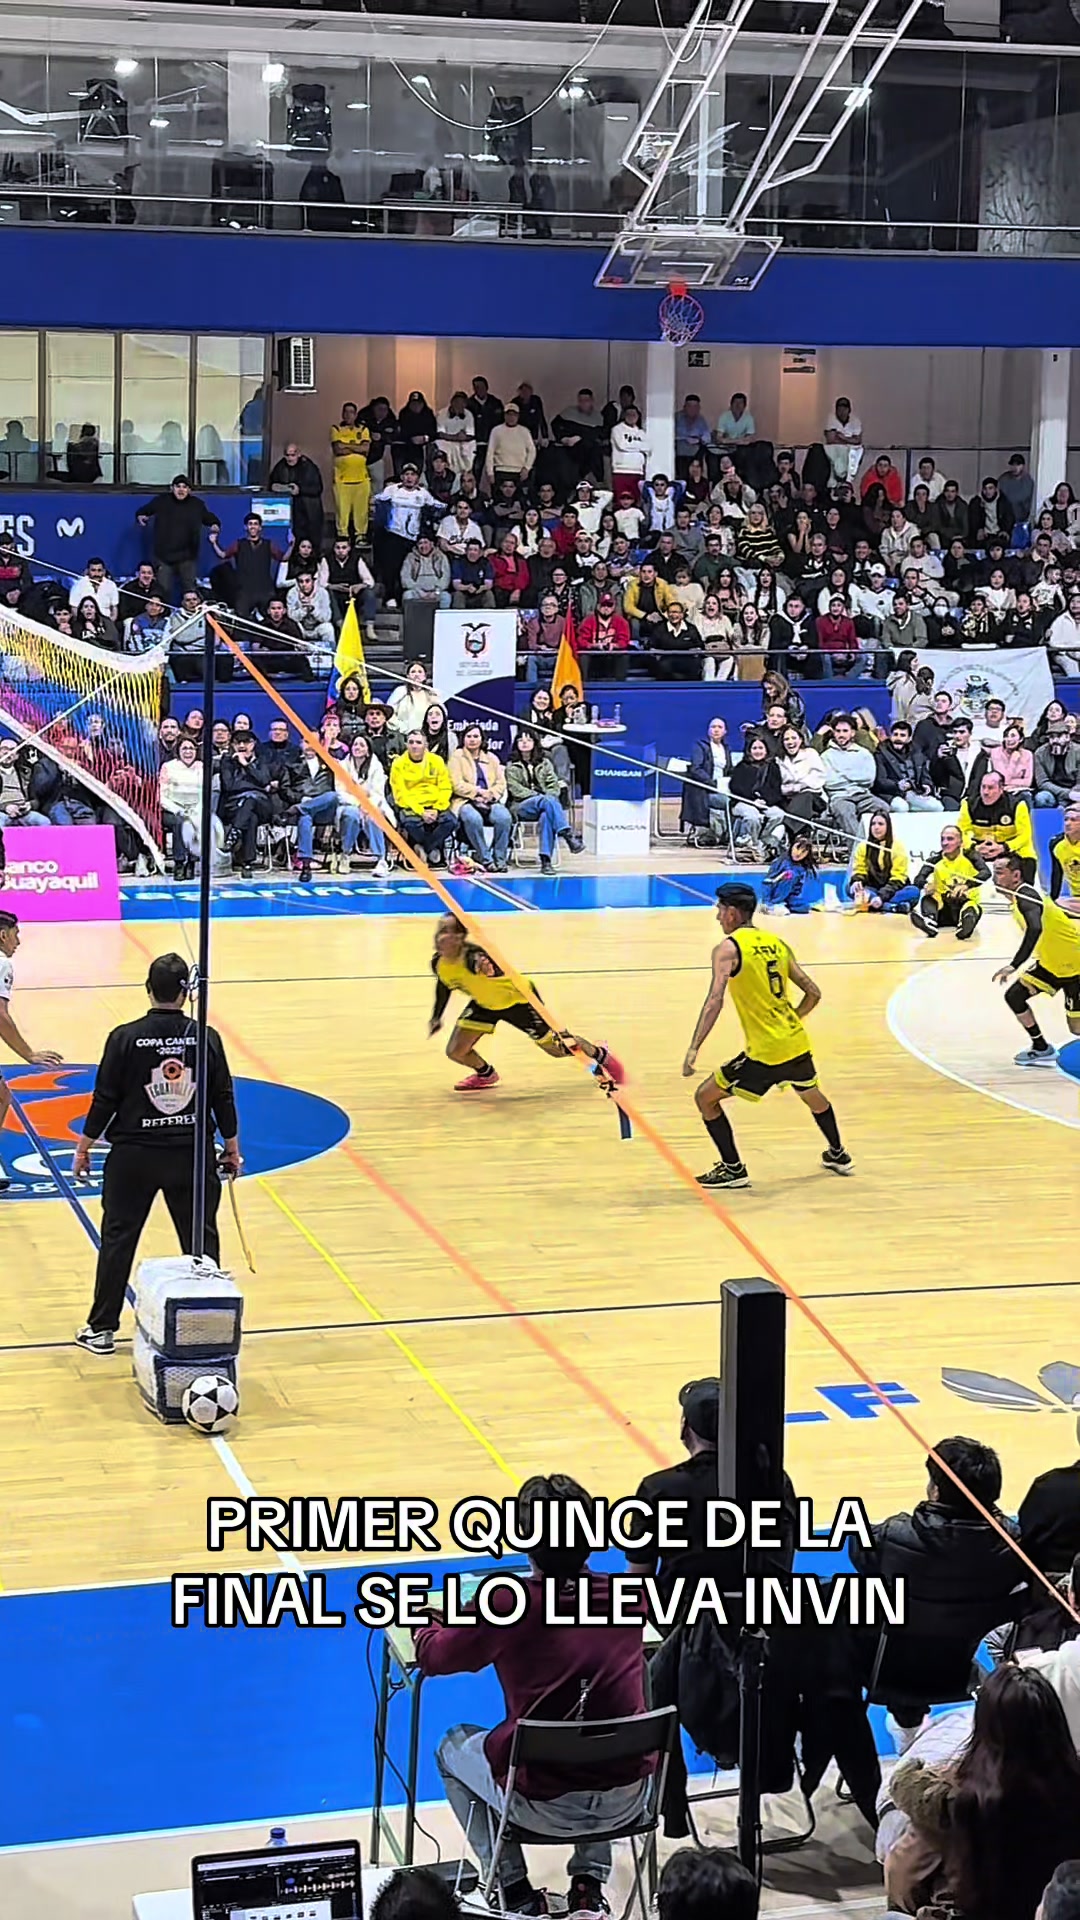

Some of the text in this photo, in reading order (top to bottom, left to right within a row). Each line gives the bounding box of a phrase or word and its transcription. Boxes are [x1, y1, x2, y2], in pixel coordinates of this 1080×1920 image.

[4, 861, 59, 874] anco
[766, 959, 784, 999] 6
[136, 1037, 197, 1048] COPA CANEL
